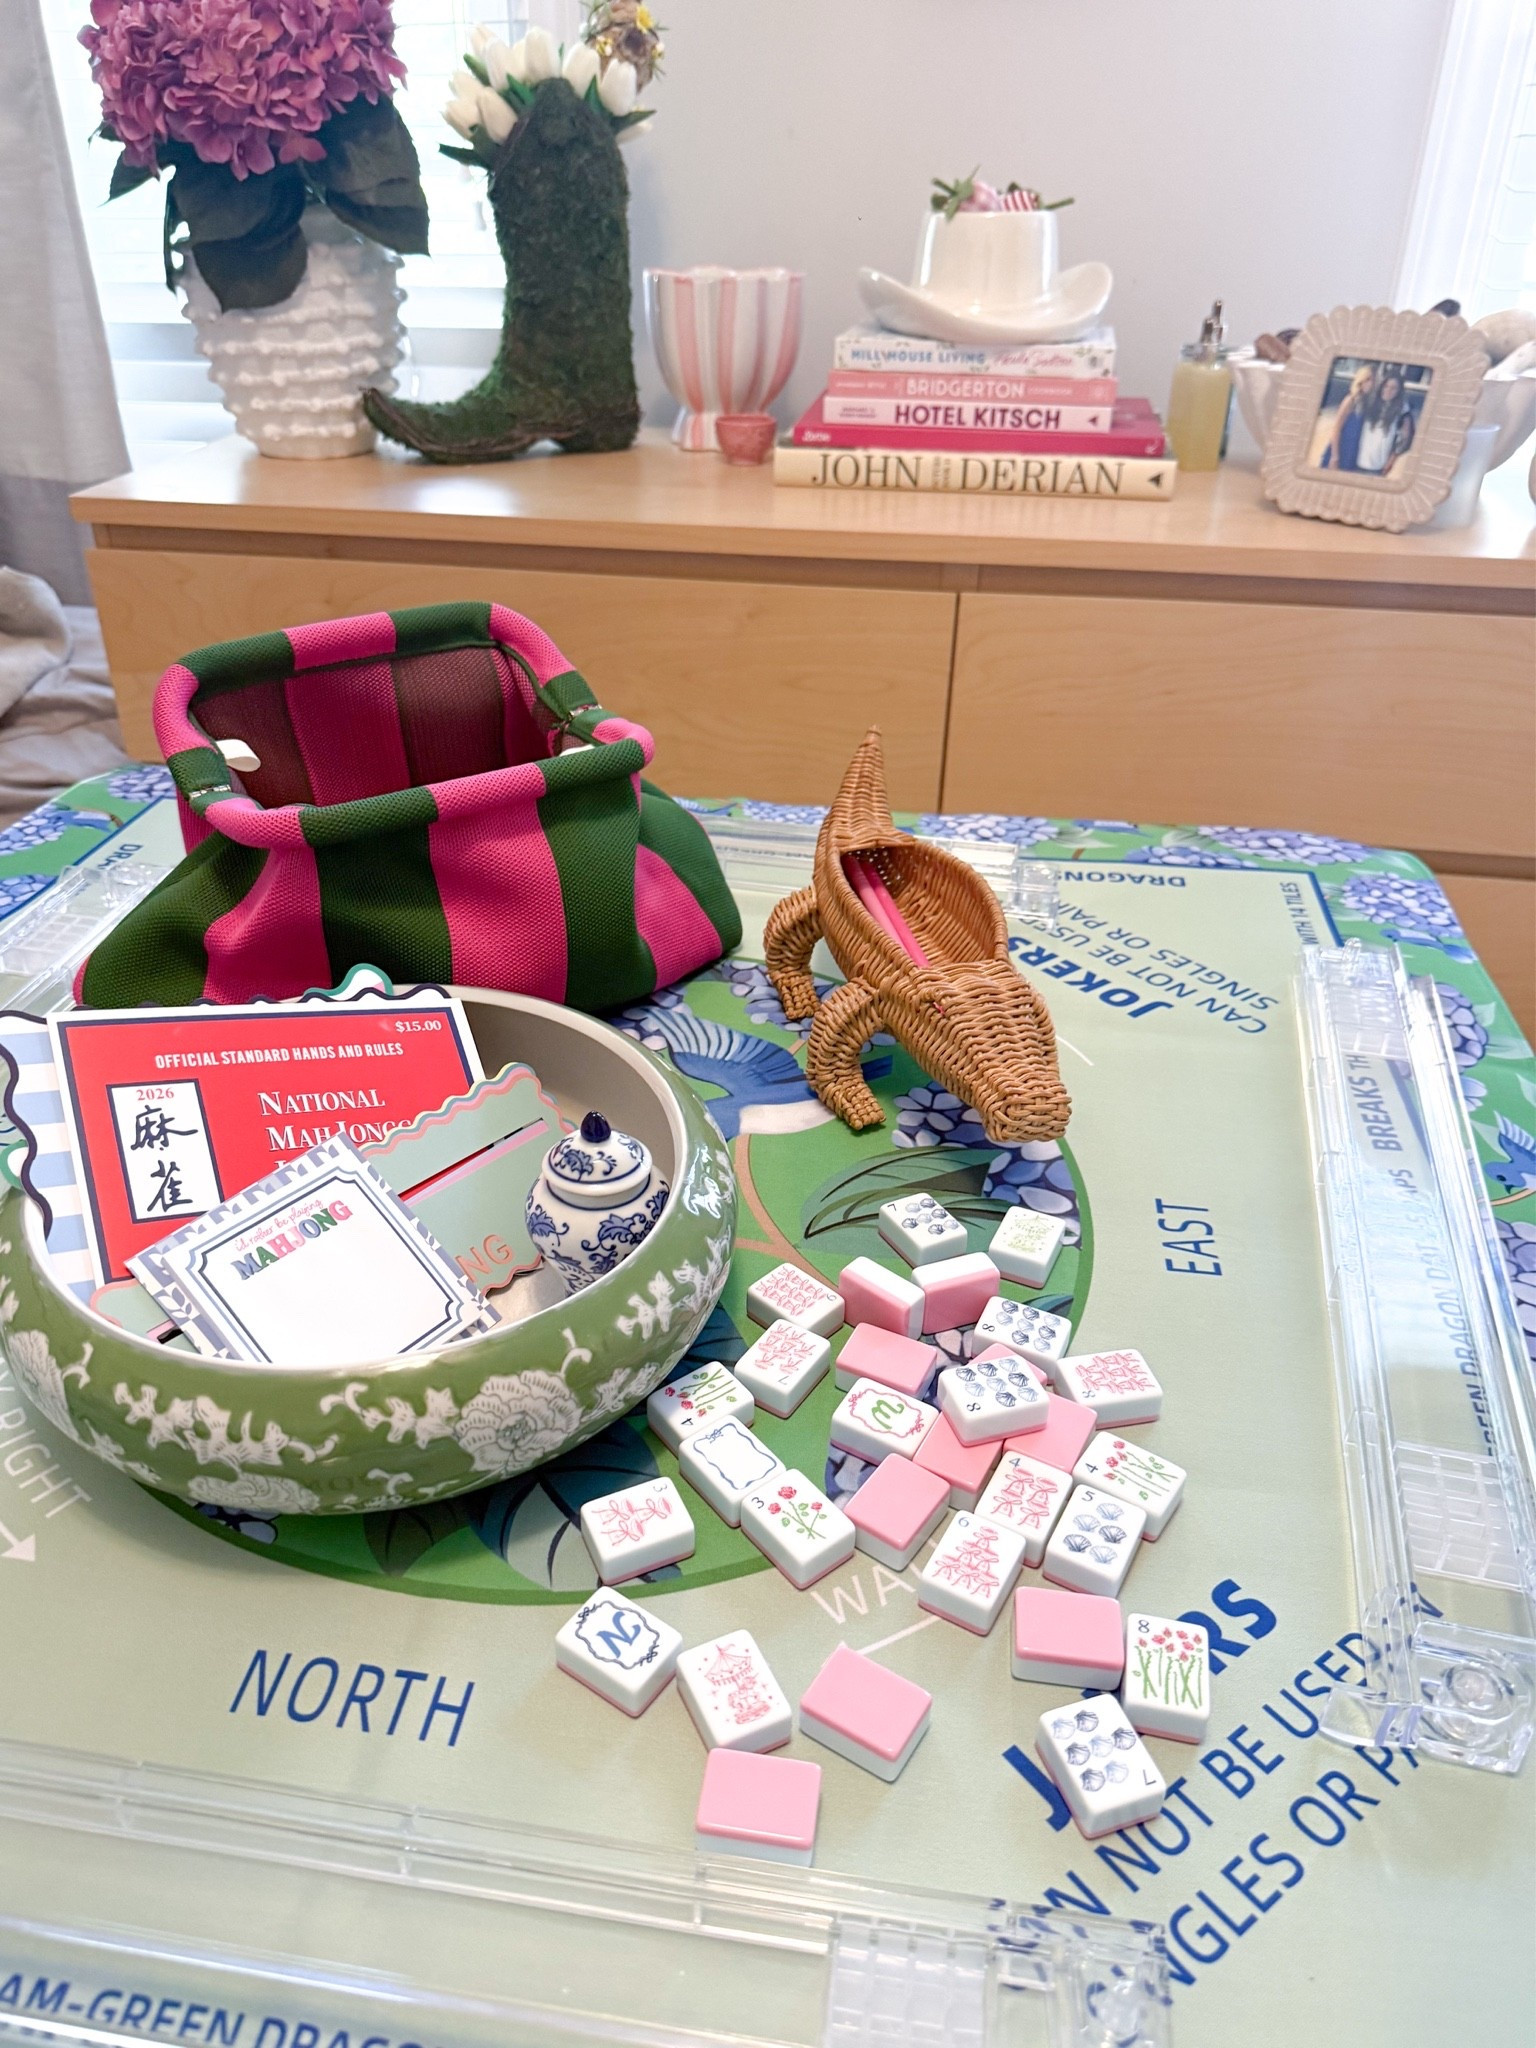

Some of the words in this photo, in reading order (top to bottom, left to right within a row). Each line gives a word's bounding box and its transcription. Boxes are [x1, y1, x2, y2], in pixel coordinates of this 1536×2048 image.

[906, 378, 1026, 399] BRIDGERTON
[895, 405, 967, 428] HOTEL
[974, 408, 1060, 430] KITSCH
[812, 453, 923, 488] JOHN
[961, 458, 1126, 495] DERIAN
[1056, 870, 1187, 888] DRAGON
[1106, 924, 1150, 949] OR
[1088, 944, 1133, 967] BE
[1007, 936, 1175, 1019] JOKERS
[1126, 965, 1198, 998] NOT
[1149, 948, 1279, 1011] SINGLES
[395, 1020, 442, 1033] $15.00
[1197, 997, 1268, 1034] CAN
[155, 1052, 219, 1069] OFFICIAL
[220, 1048, 290, 1065] STANDARD
[292, 1044, 336, 1060] HANDS
[338, 1044, 363, 1058] AND
[364, 1042, 404, 1056] RULES
[136, 1087, 175, 1101] 2026
[257, 1089, 386, 1117] NATIONAL
[1349, 1076, 1404, 1152] BREAKS
[250, 1225, 274, 1244] rather
[274, 1216, 289, 1229] be
[289, 1199, 324, 1224] playing
[230, 1200, 353, 1280] MAHJONG
[1155, 1198, 1223, 1276] EAST
[981, 1323, 996, 1333] 8
[966, 1401, 981, 1413] 8
[1081, 1390, 1096, 1399] 8
[0, 1406, 93, 1519] RIGHT
[1008, 1458, 1021, 1468] 4
[1085, 1463, 1099, 1474] 4
[653, 1483, 669, 1493] 3
[1081, 1491, 1096, 1503] 5
[751, 1496, 765, 1510] 3
[810, 1538, 938, 1625] WA
[1137, 1619, 1151, 1634] 8
[229, 1650, 475, 1747] NORTH
[1002, 1578, 1277, 1832] JRS
[1142, 1769, 1157, 1786] 7
[1094, 1776, 1213, 1893] NOT
[1200, 1724, 1284, 1798] BE
[1289, 1770, 1381, 1847] OR
